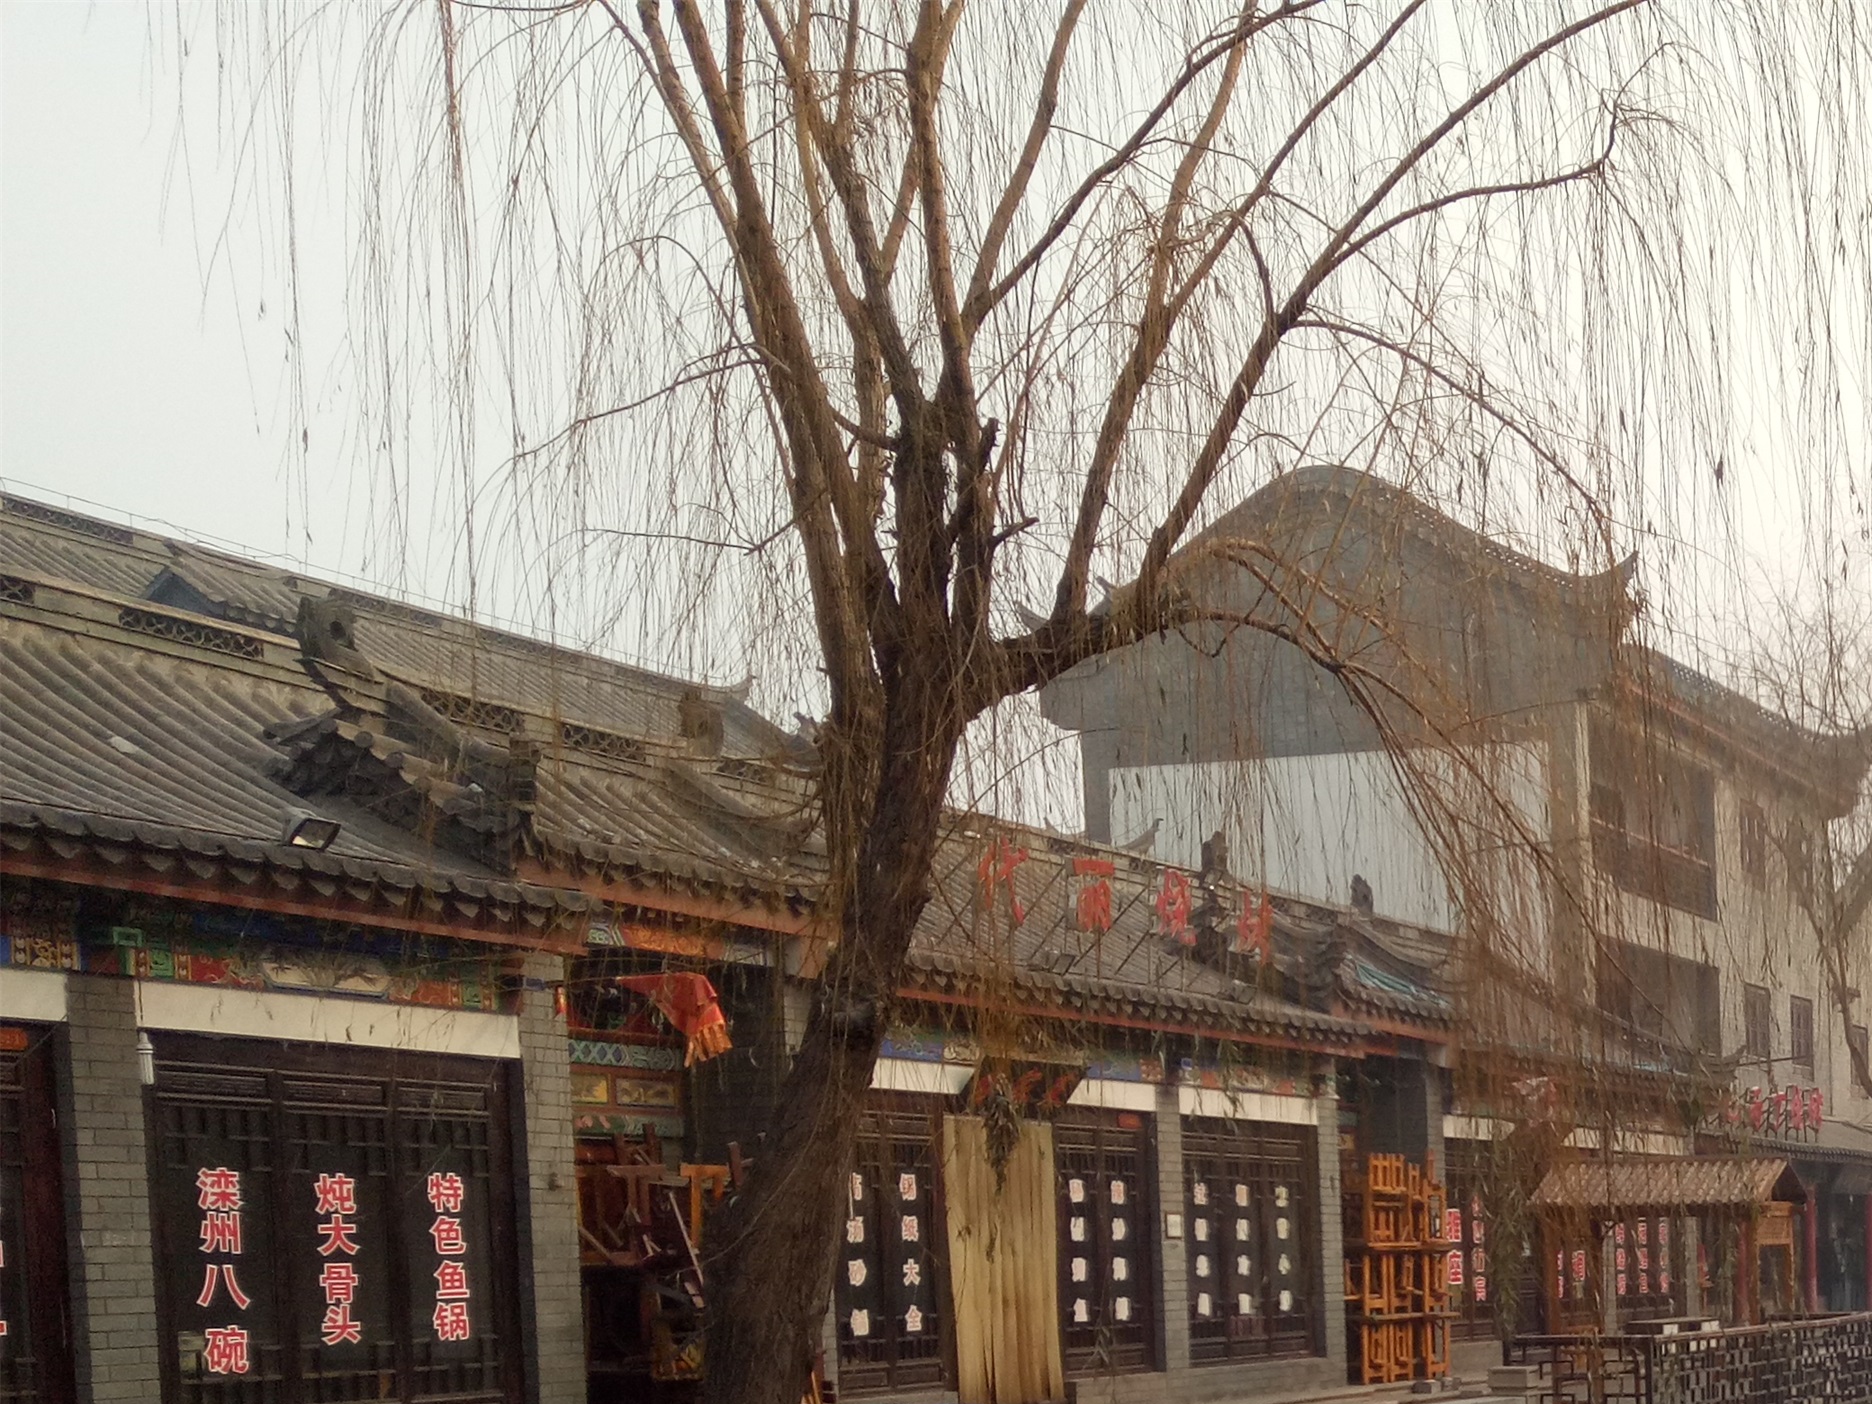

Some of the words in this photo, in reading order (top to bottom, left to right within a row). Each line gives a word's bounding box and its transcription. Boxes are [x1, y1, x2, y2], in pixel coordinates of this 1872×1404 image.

[197, 1166, 250, 1375] 滦州八碗
[314, 1172, 361, 1346] 炖大骨头
[426, 1171, 470, 1342] 特色鱼锅
